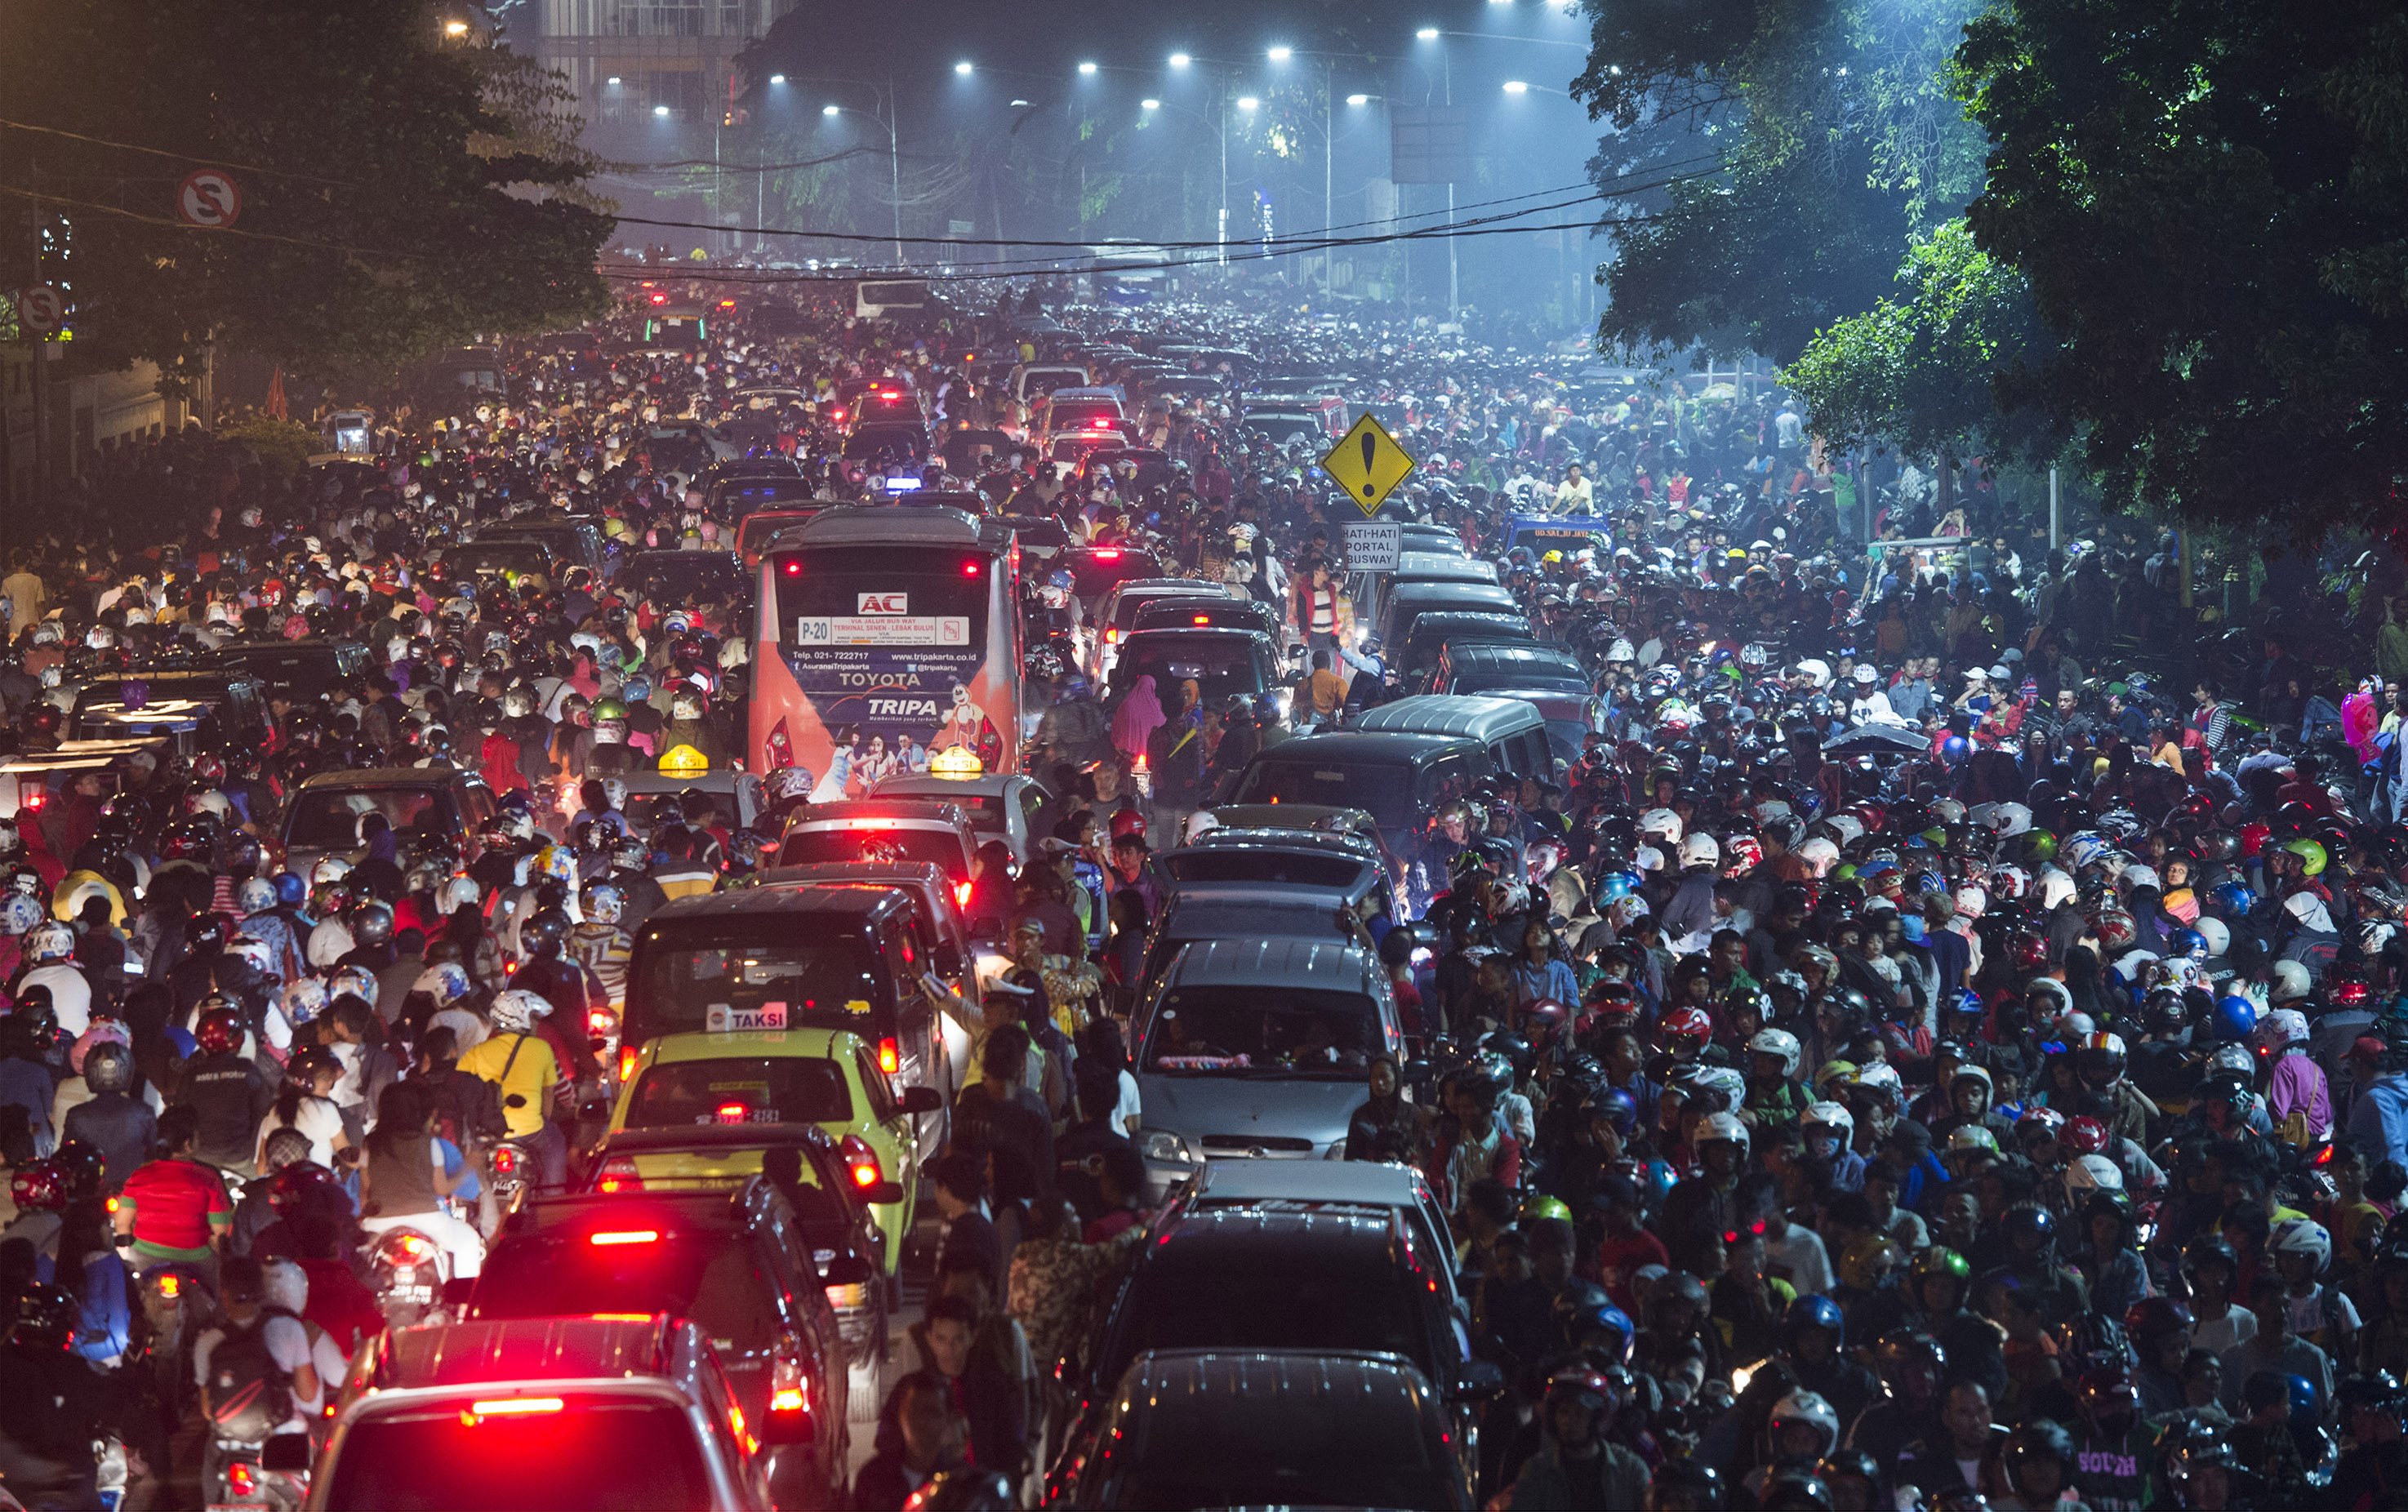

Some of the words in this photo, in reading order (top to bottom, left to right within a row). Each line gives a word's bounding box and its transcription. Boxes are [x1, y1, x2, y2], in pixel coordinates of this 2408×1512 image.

[197, 183, 222, 218] S
[1342, 529, 1396, 539] HATI-HATI
[1347, 555, 1392, 564] BUSWAY
[861, 595, 905, 612] AC
[803, 622, 827, 640] P-20
[793, 651, 812, 660] Telp.
[835, 651, 869, 660] 7222717
[892, 653, 977, 661] www.tripakarta.co.id
[803, 663, 870, 671] AsuransiTripakarta
[917, 664, 958, 672] @tripakarta
[839, 673, 921, 686] TOYOTA
[869, 699, 937, 715] TRIPA
[941, 760, 973, 768] TSI
[733, 1013, 783, 1027] TAKSI
